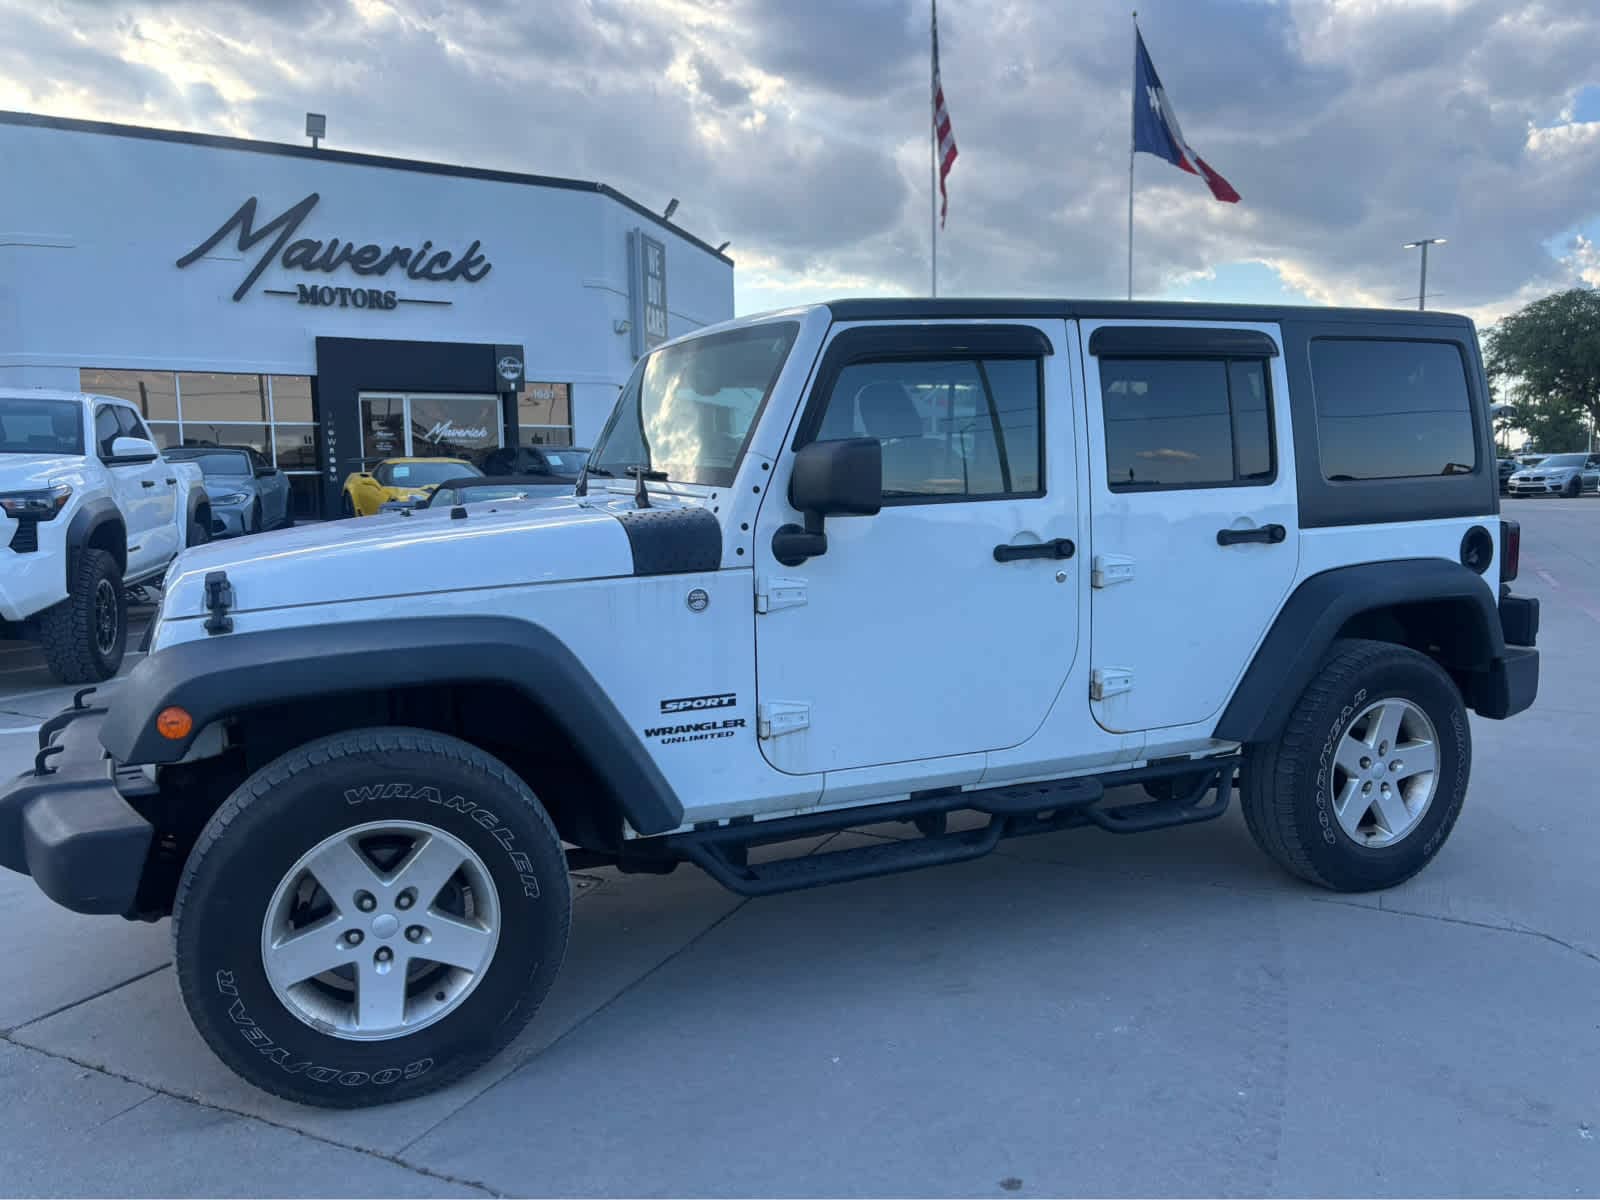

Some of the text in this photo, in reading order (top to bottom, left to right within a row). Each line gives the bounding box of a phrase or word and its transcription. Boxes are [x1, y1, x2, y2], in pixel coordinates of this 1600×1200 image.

[176, 192, 492, 302] Maverick
[297, 283, 398, 311] MOTORS
[423, 419, 489, 445] Maverick
[663, 695, 731, 712] SPORT
[644, 718, 747, 739] WRANGLER
[660, 730, 735, 745] UNLIMITED
[1315, 688, 1368, 845] GOODYEAR
[344, 783, 543, 899] WRANGLER
[216, 968, 435, 1086] GOODYEAR
